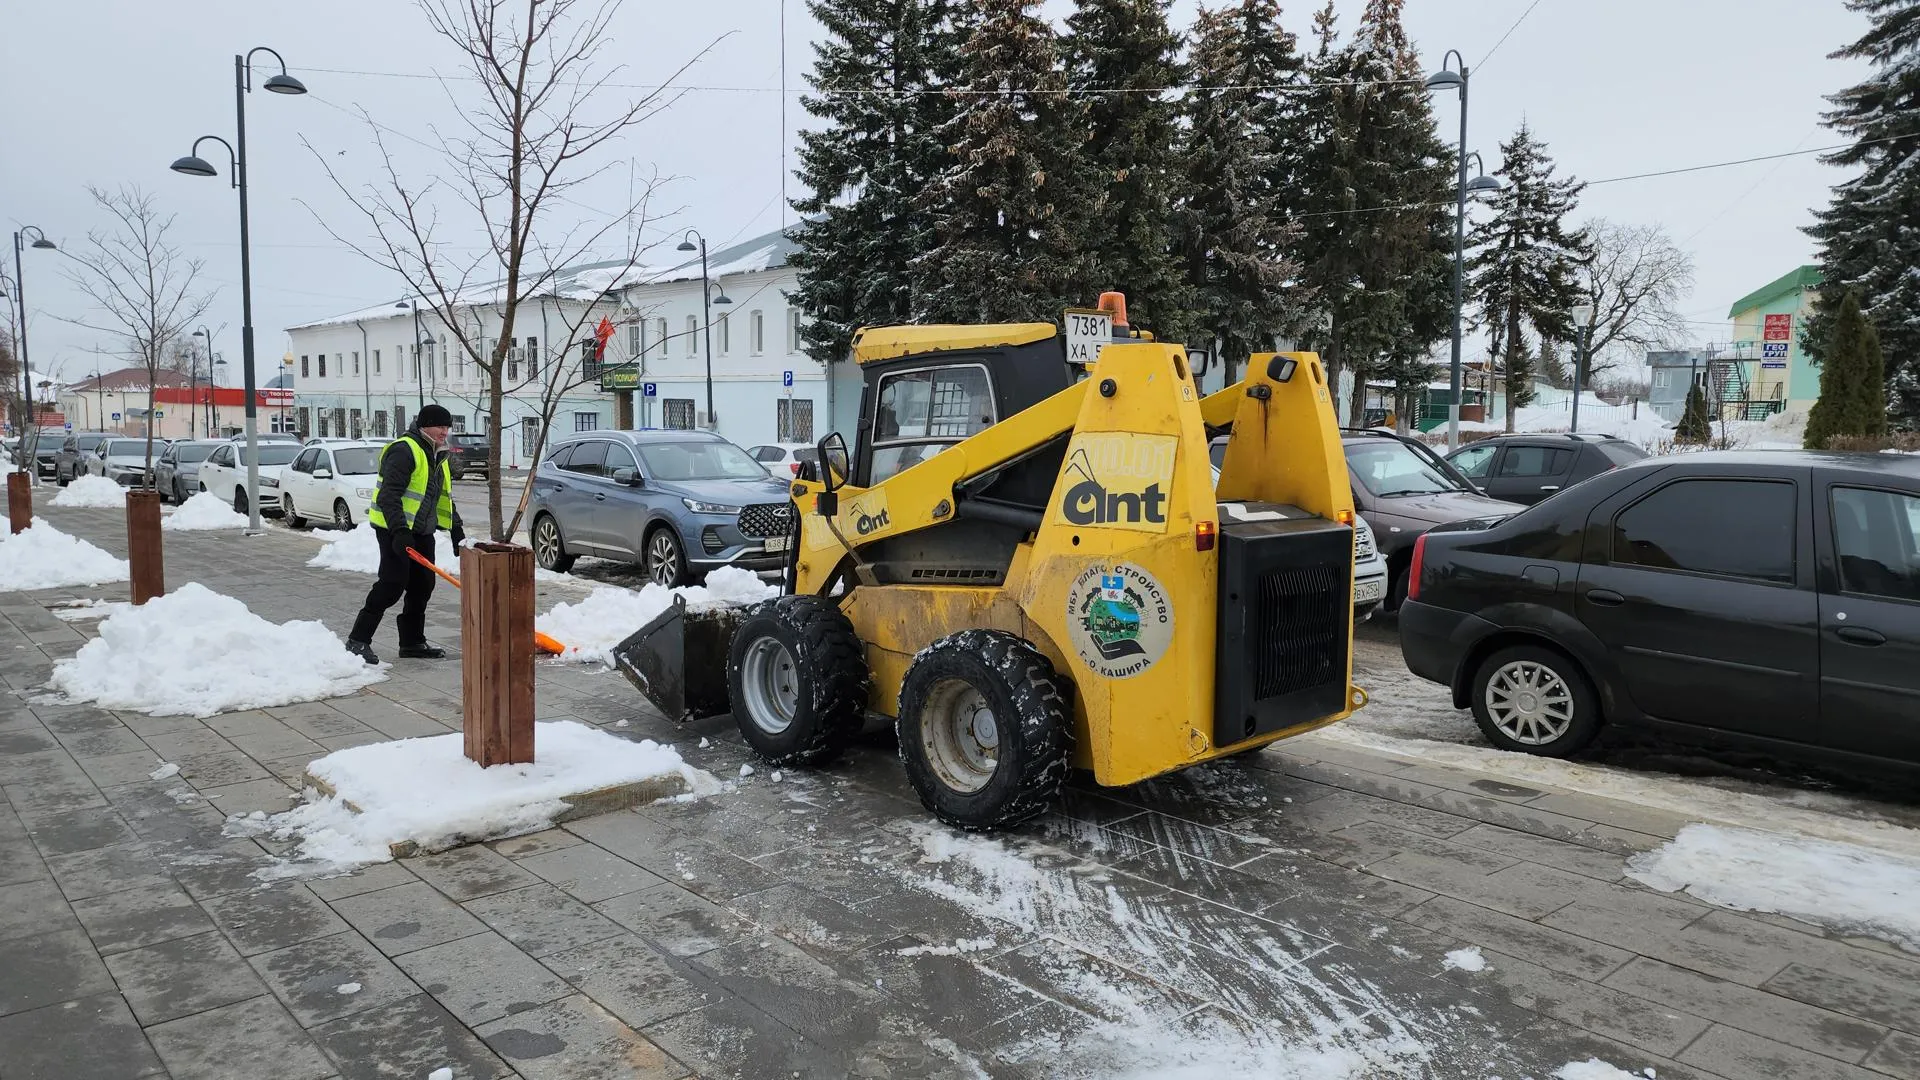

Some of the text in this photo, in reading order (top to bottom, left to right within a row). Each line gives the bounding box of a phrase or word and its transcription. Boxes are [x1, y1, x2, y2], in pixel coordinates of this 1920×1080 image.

[1072, 315, 1106, 336] 7381
[785, 372, 792, 385] P
[646, 384, 655, 395] P
[1068, 589, 1078, 615] МБУ
[1100, 658, 1152, 678] КАШИРА
